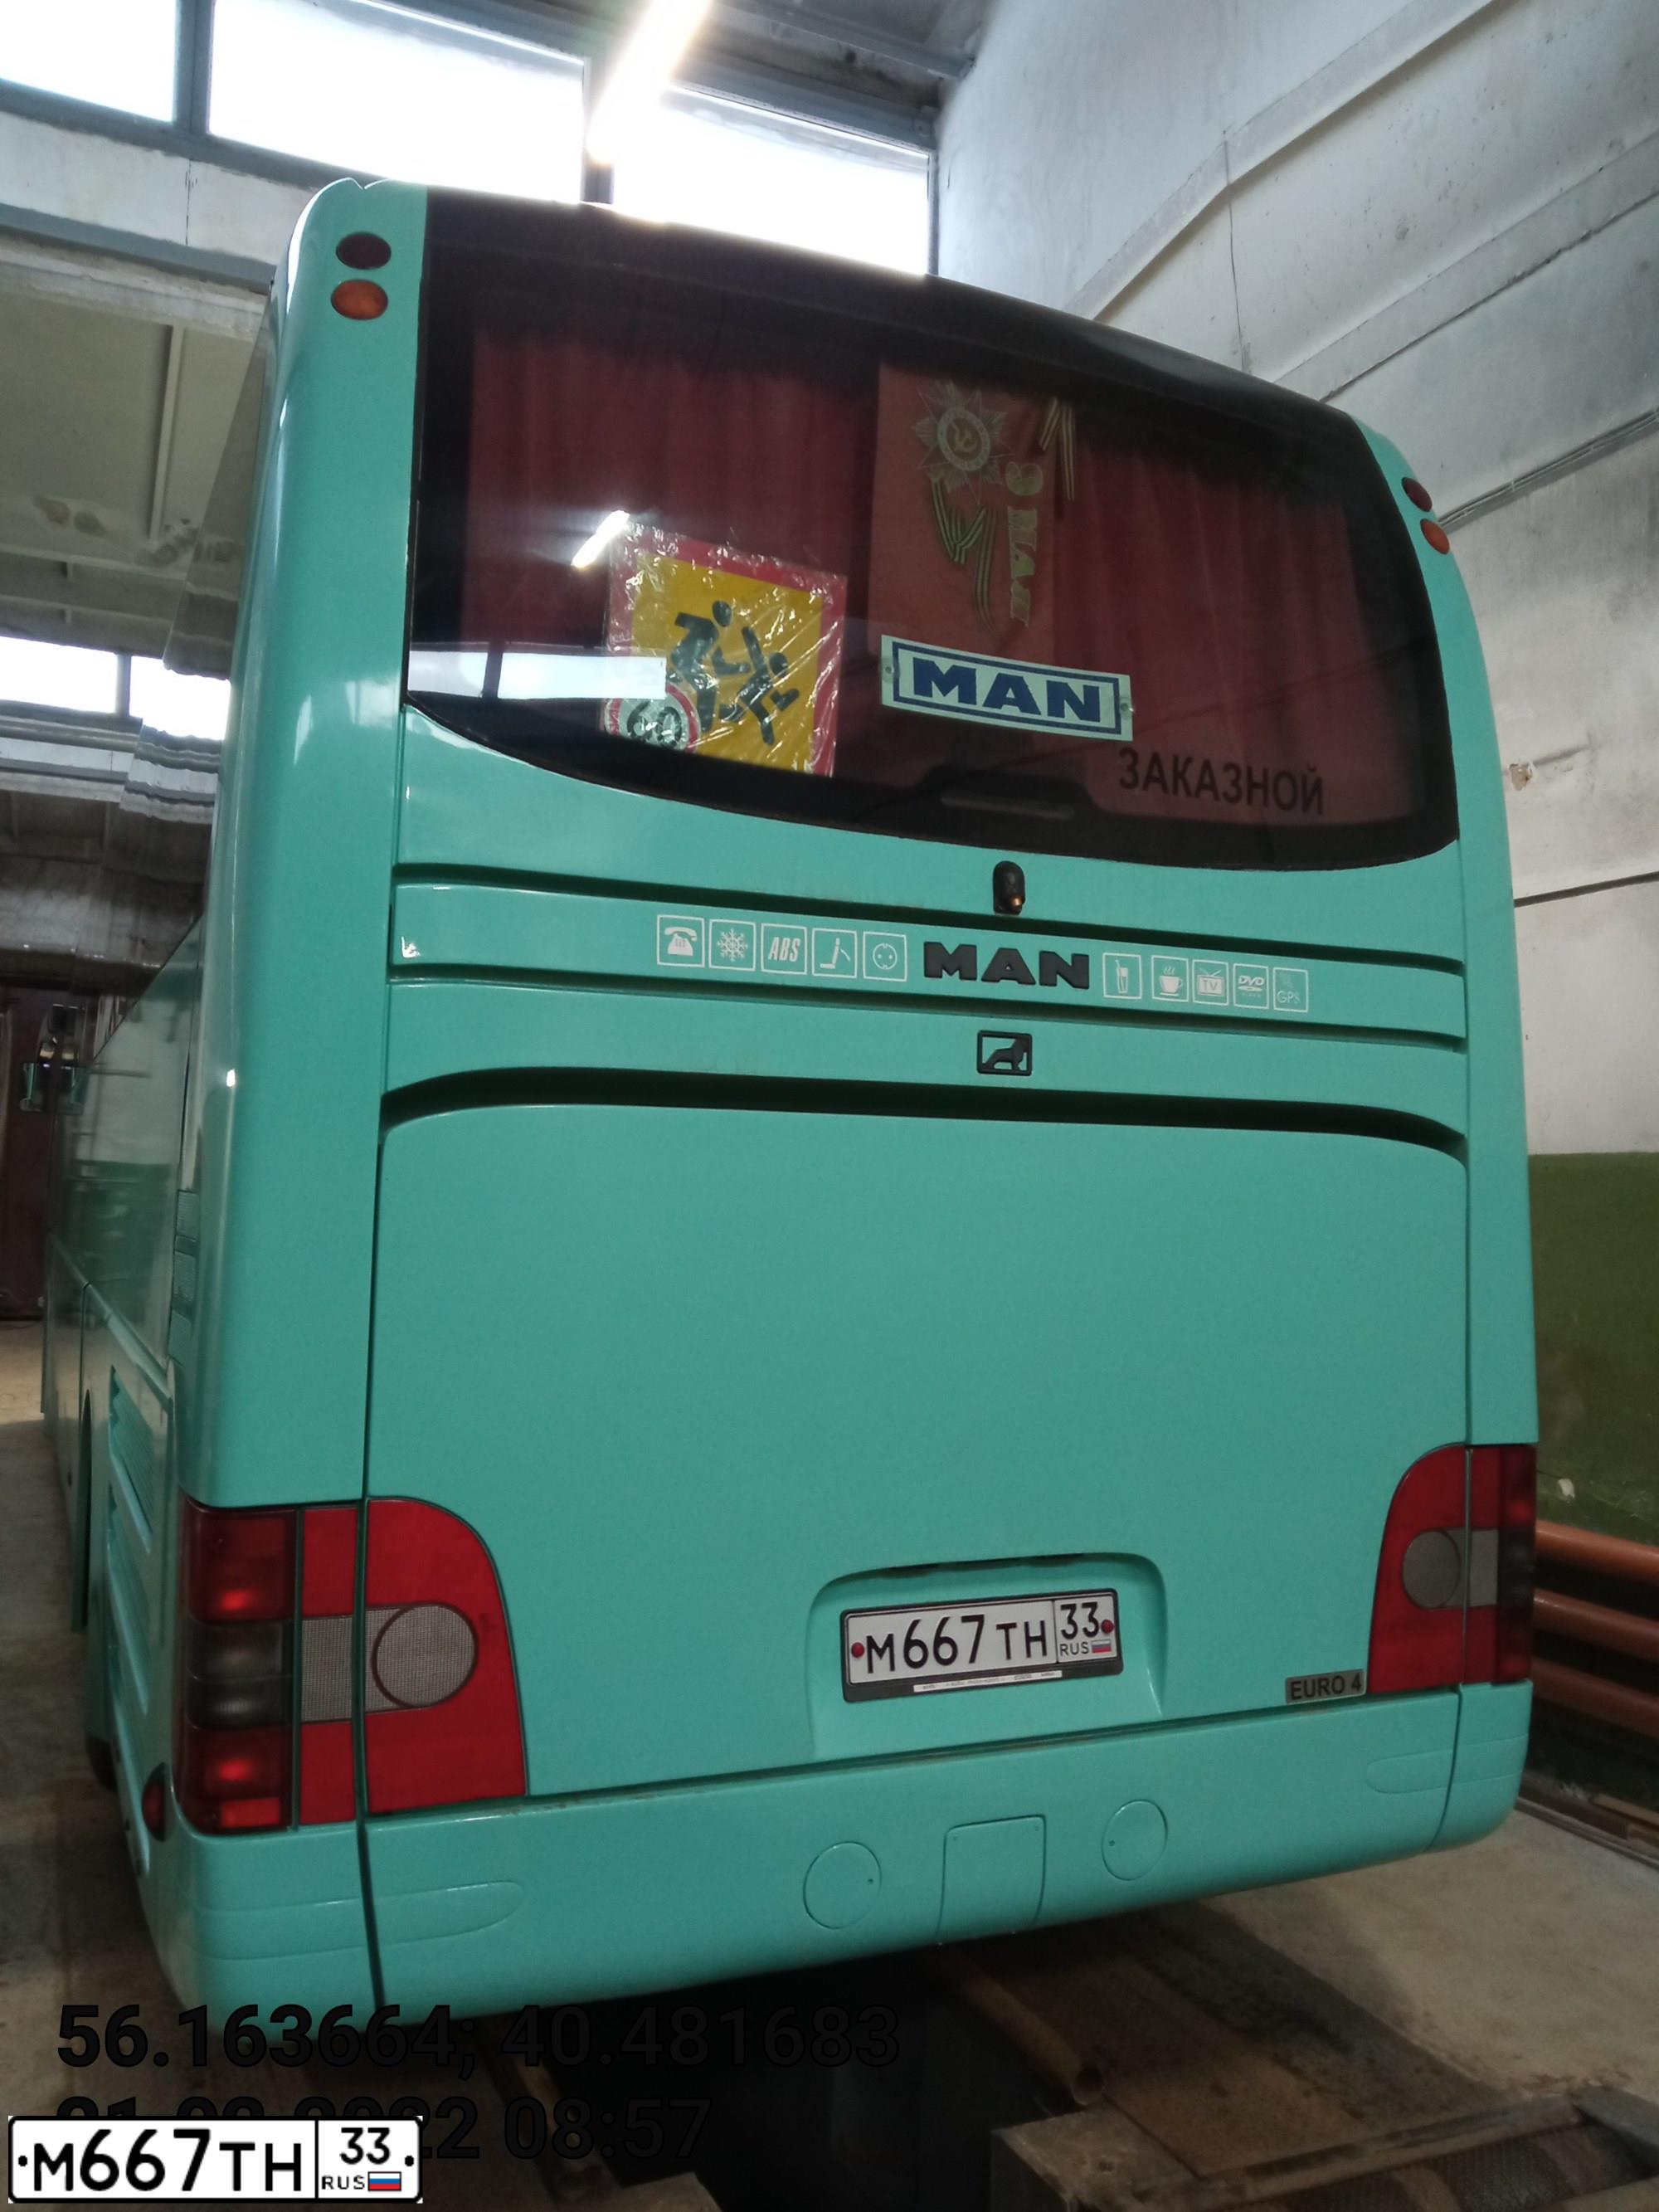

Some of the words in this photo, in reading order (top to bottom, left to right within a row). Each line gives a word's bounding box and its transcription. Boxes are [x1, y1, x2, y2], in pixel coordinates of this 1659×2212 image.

[912, 658, 1101, 723] MAN
[1118, 747, 1325, 816] ЗАКАЗНОЙ
[768, 937, 800, 962] ABS
[923, 941, 1090, 990] MAN
[1201, 979, 1219, 992] TV
[1238, 975, 1265, 987] DVD
[1277, 990, 1301, 1005] GPS
[1060, 1601, 1100, 1640] 33
[1059, 1641, 1090, 1656] RUS
[1290, 1674, 1345, 1700] EURO
[1350, 1672, 1363, 1692] 4
